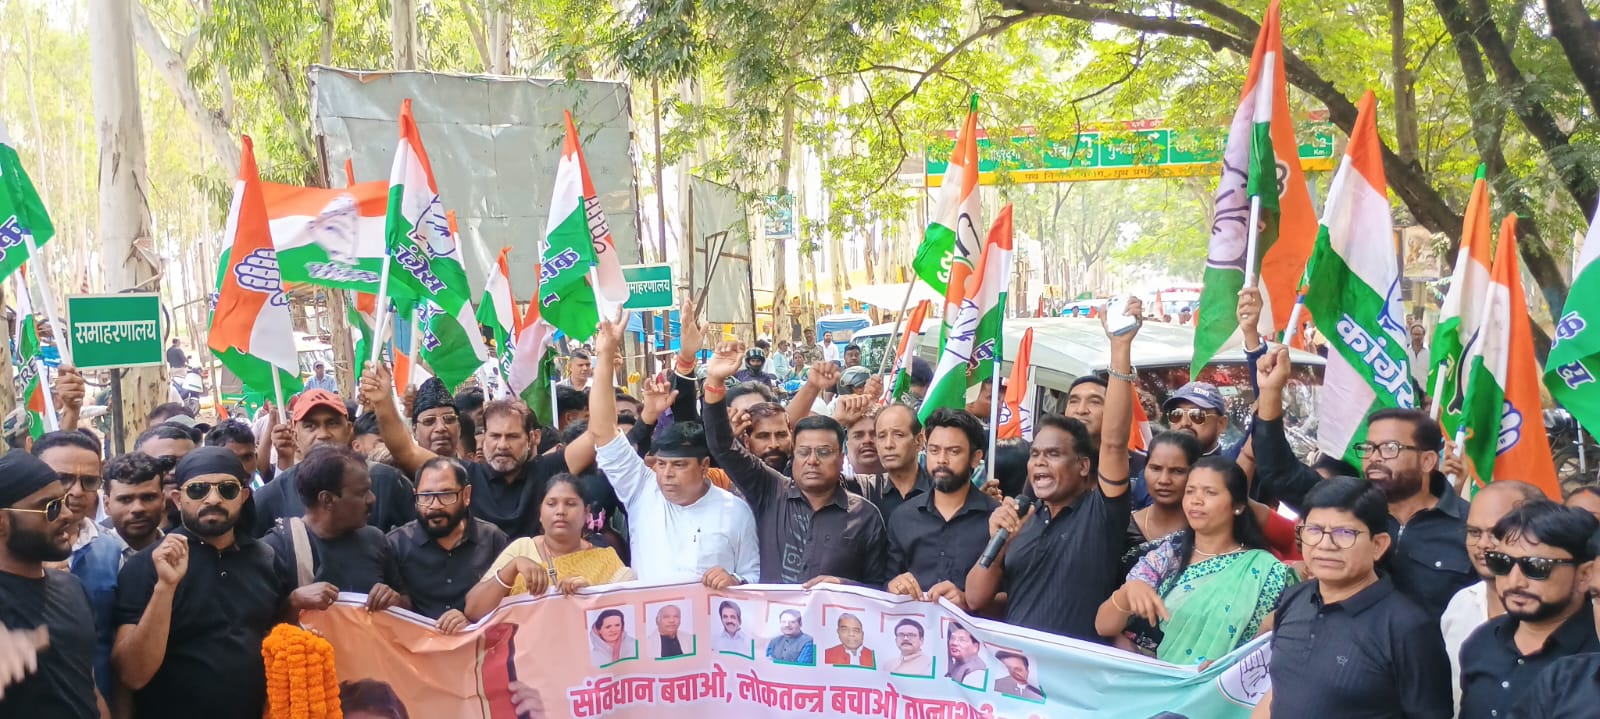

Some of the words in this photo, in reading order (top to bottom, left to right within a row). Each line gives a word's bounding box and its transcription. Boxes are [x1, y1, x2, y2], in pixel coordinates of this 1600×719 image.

[74, 319, 157, 345] समाहरणालय
[569, 676, 656, 718] संविधान
[659, 663, 732, 704] बचाओ,
[736, 668, 827, 714] लोकतन्त्र
[829, 682, 900, 719] बचाओ
